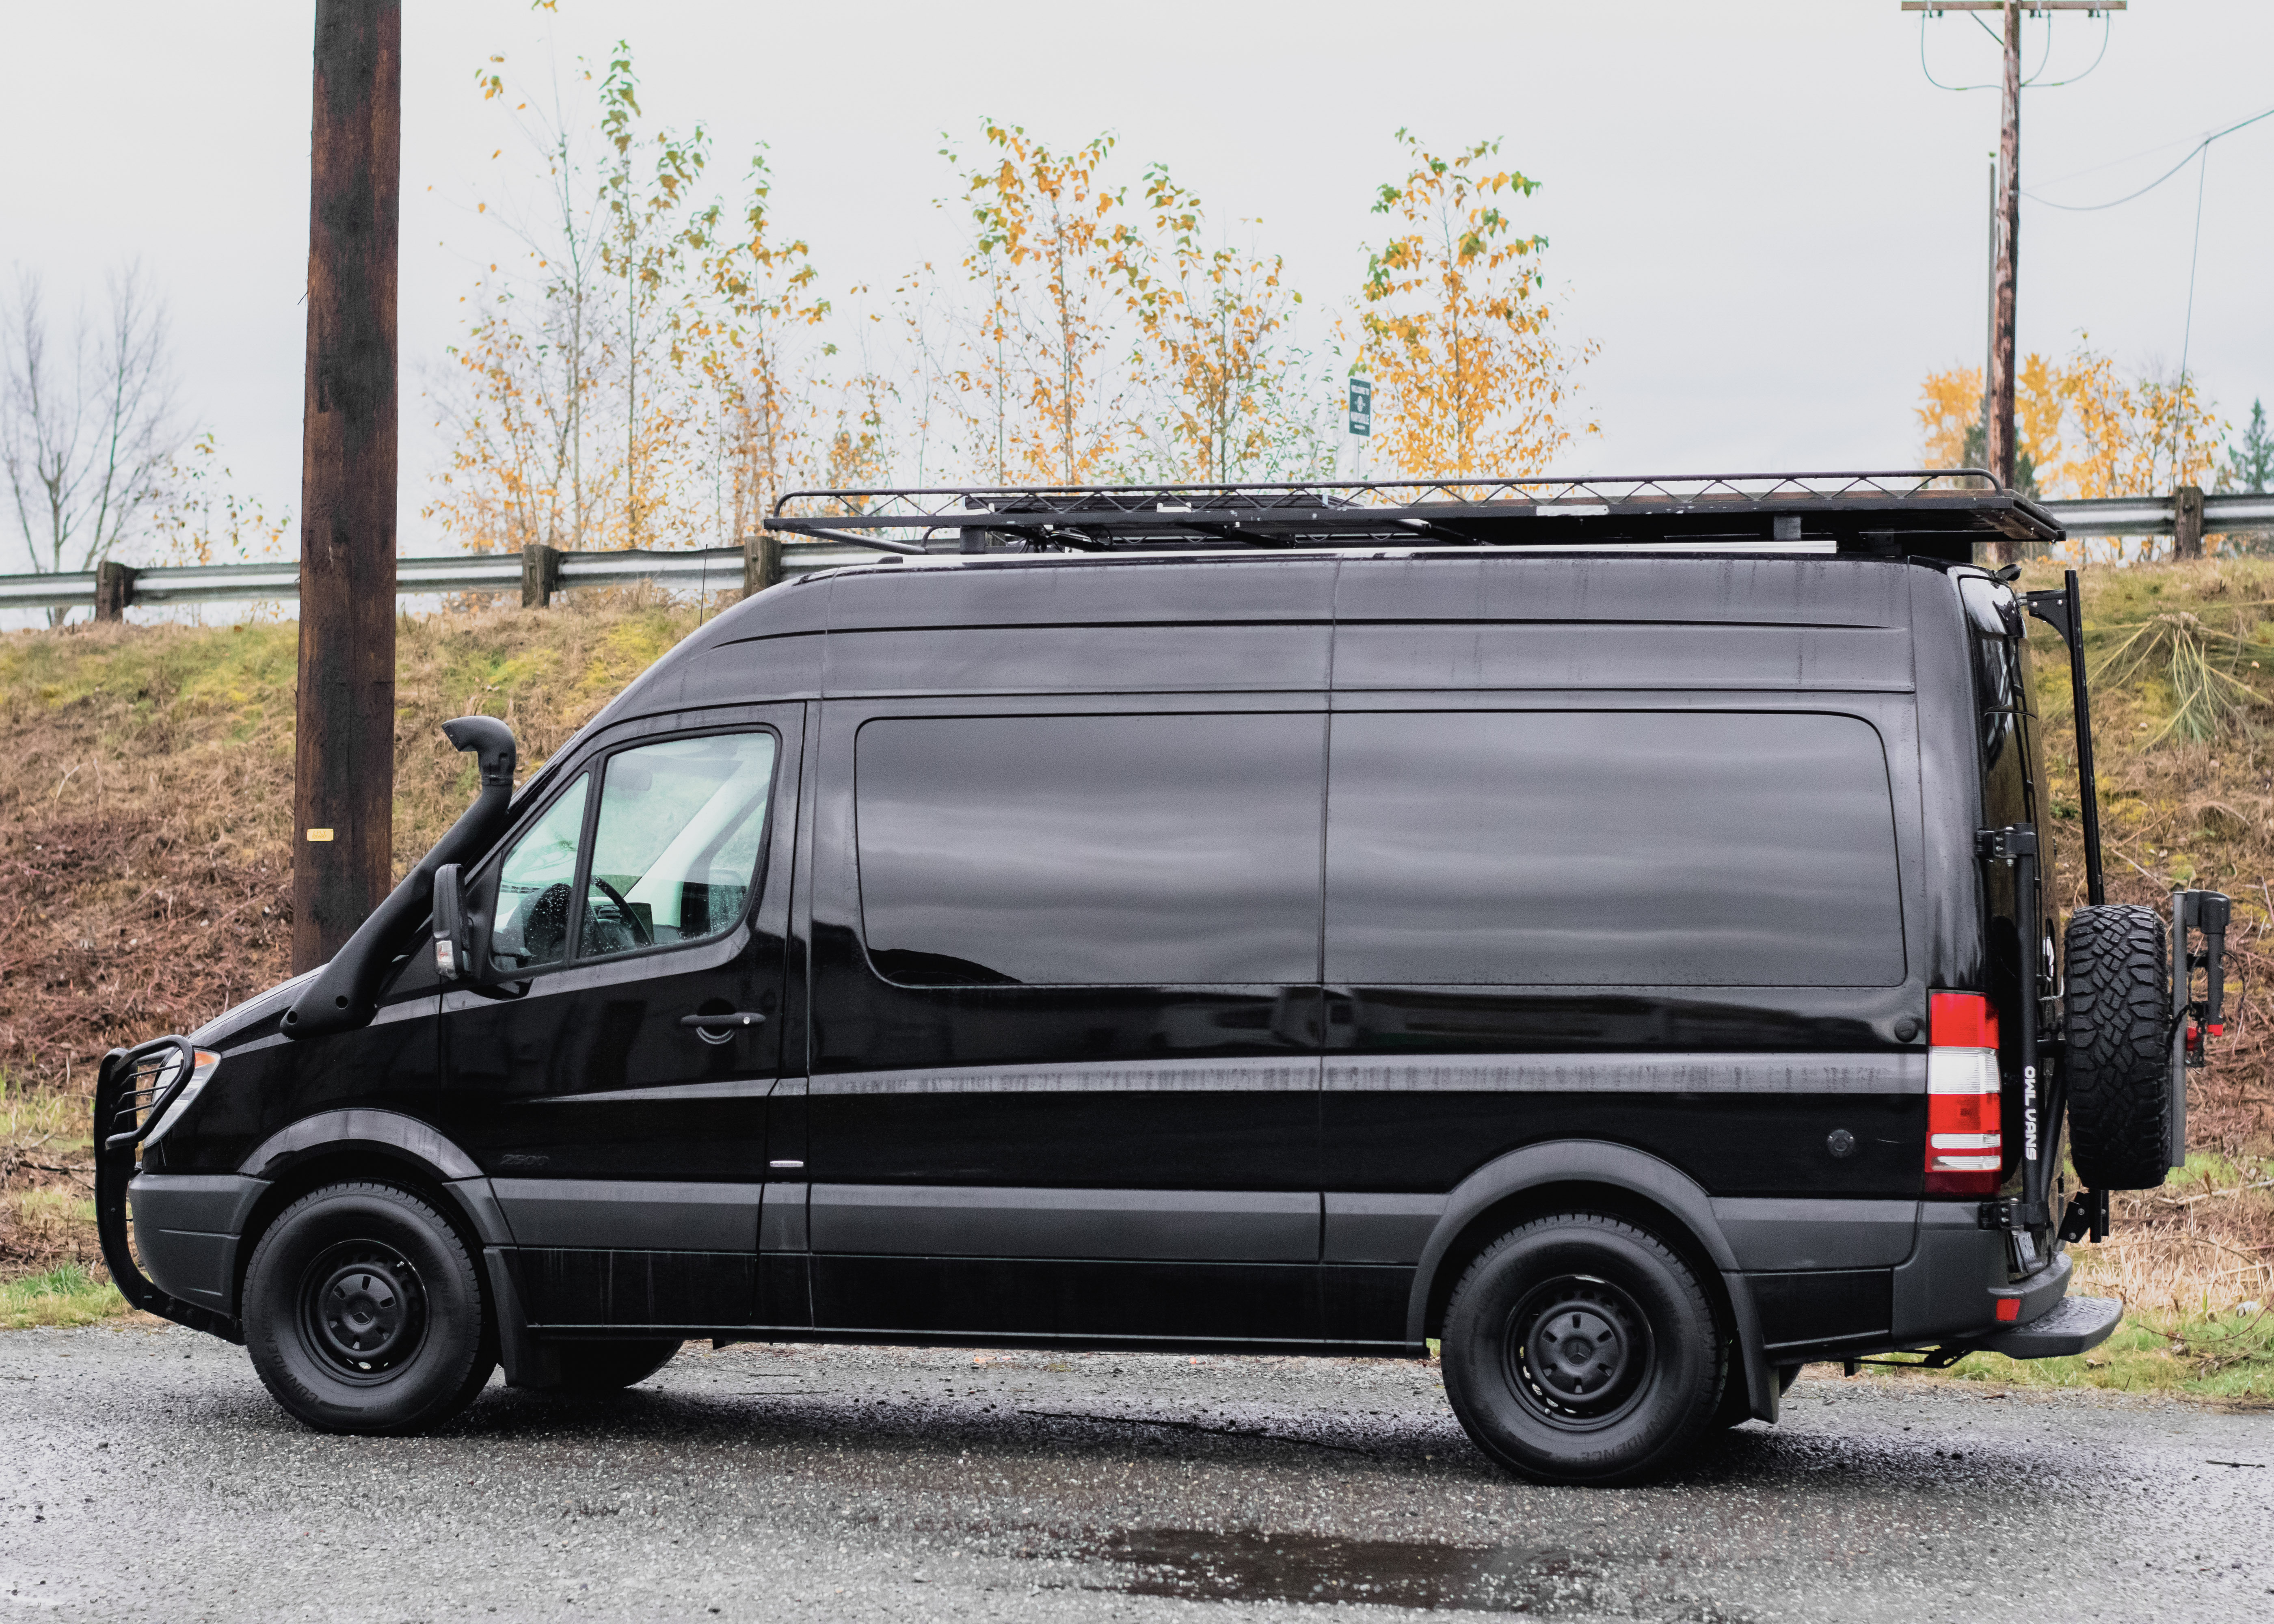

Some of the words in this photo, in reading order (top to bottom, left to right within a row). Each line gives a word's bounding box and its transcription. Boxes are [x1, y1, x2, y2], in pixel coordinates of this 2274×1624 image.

[2024, 1066, 2036, 1106] OWL
[2025, 1108, 2037, 1160] VANS
[501, 1154, 549, 1166] 2500
